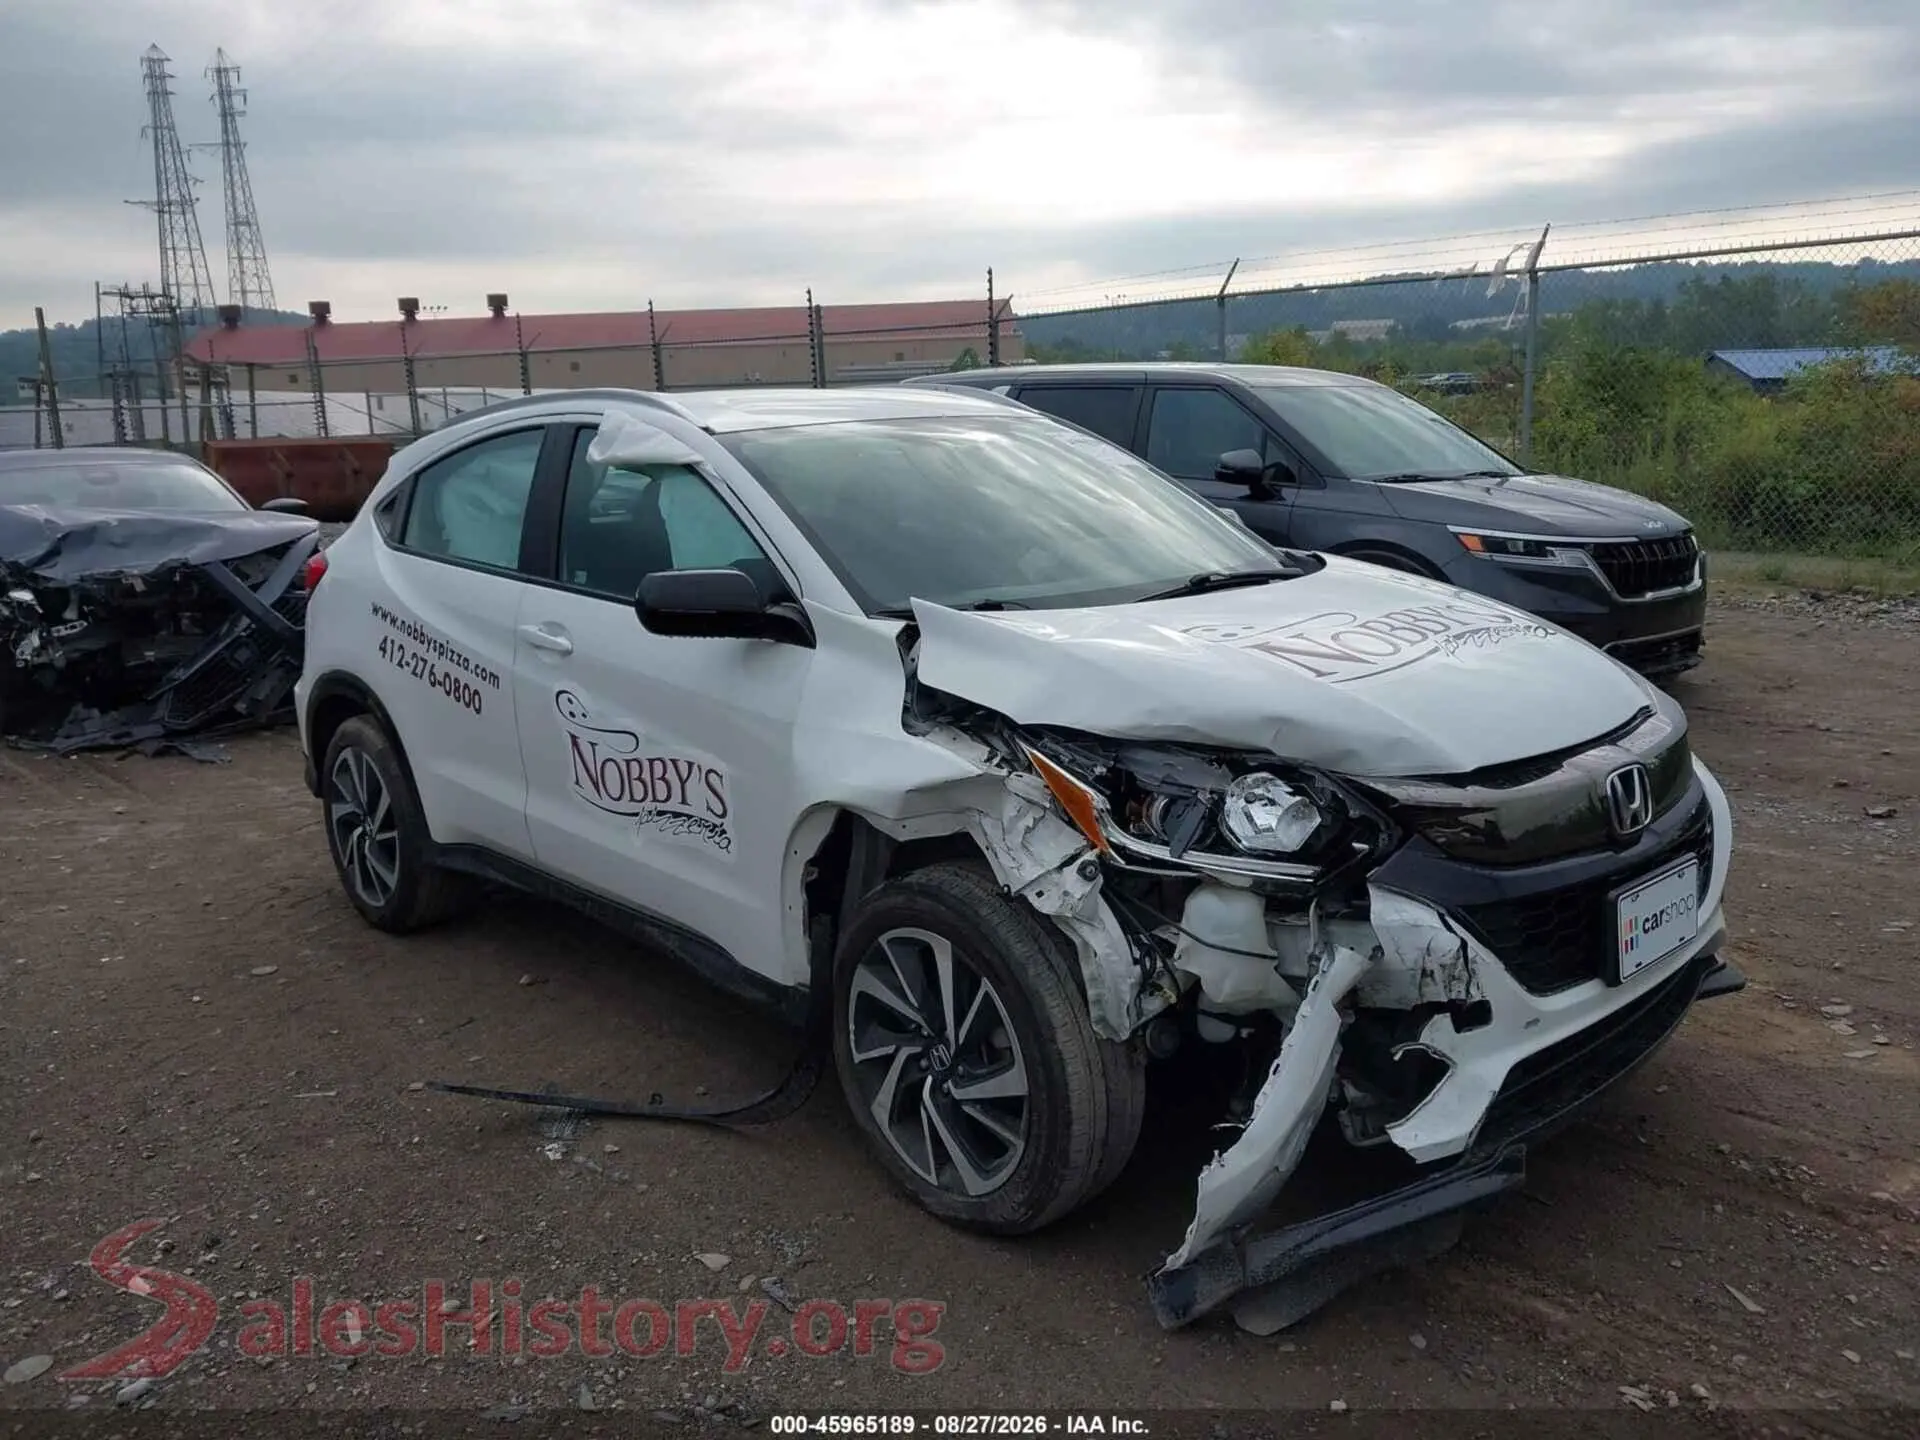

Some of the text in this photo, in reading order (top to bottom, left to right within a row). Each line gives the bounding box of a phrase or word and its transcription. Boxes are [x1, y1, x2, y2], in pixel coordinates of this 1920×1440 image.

[371, 602, 500, 690] www.nobbyspizza.com
[379, 635, 482, 715] 412-276-0800
[566, 729, 728, 819] NOBBY'S
